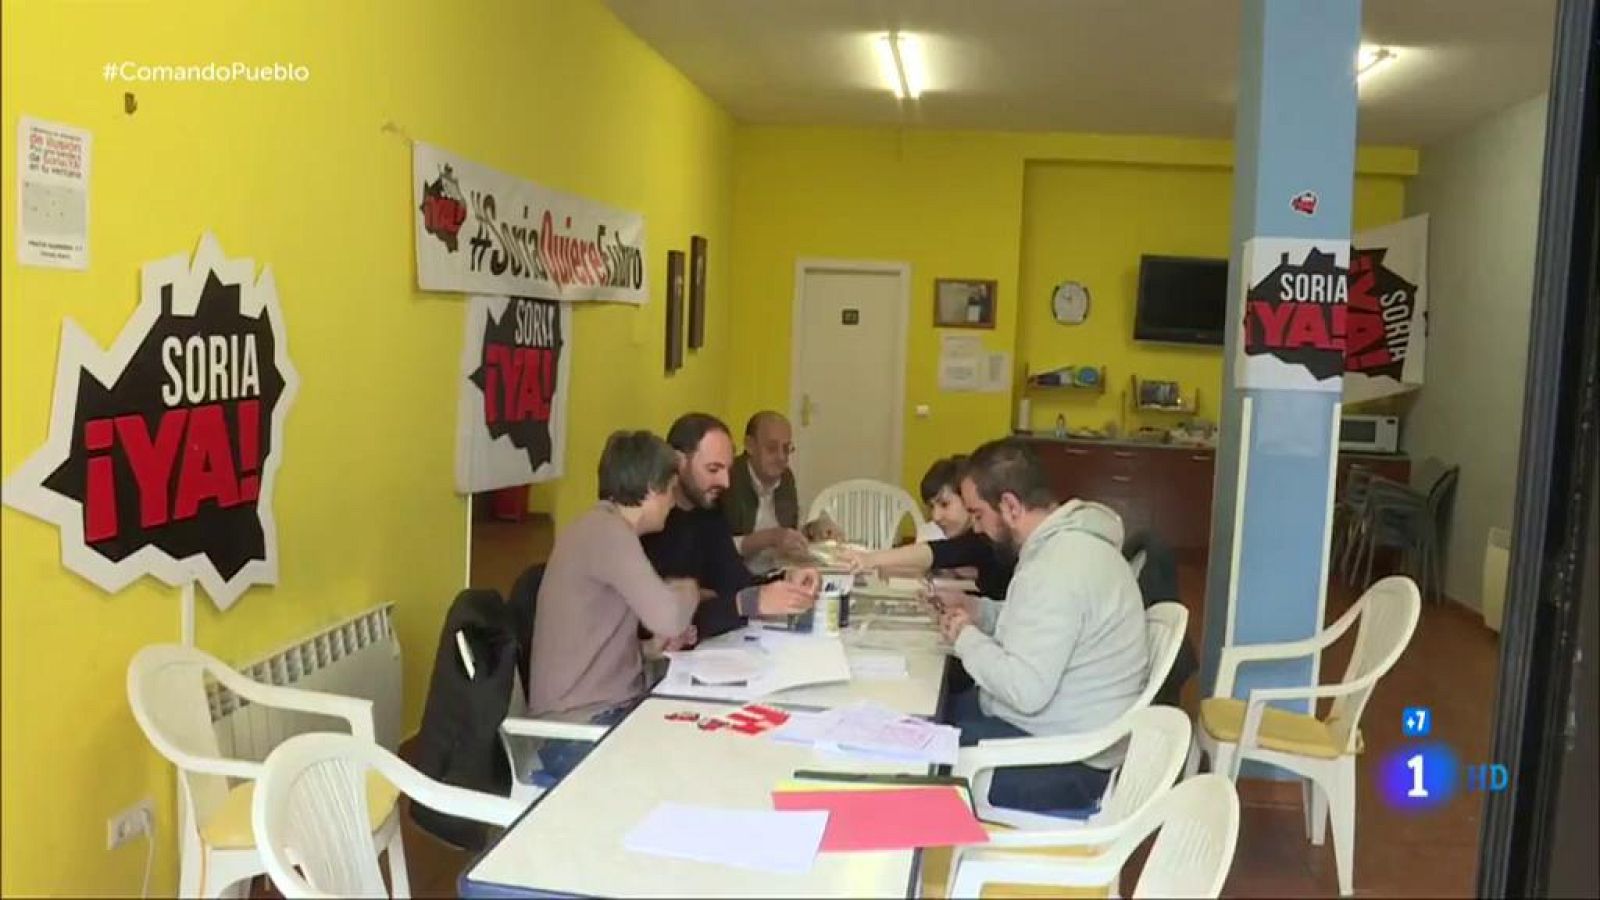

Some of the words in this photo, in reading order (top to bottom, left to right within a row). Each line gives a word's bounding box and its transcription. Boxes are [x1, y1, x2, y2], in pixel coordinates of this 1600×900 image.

[514, 299, 554, 348] SORIA
[1280, 272, 1348, 303] SORIA
[1380, 289, 1410, 362] SORIA
[162, 333, 261, 408] SORIA
[485, 342, 552, 424] ¡YA!
[85, 399, 261, 544] ¡YA!
